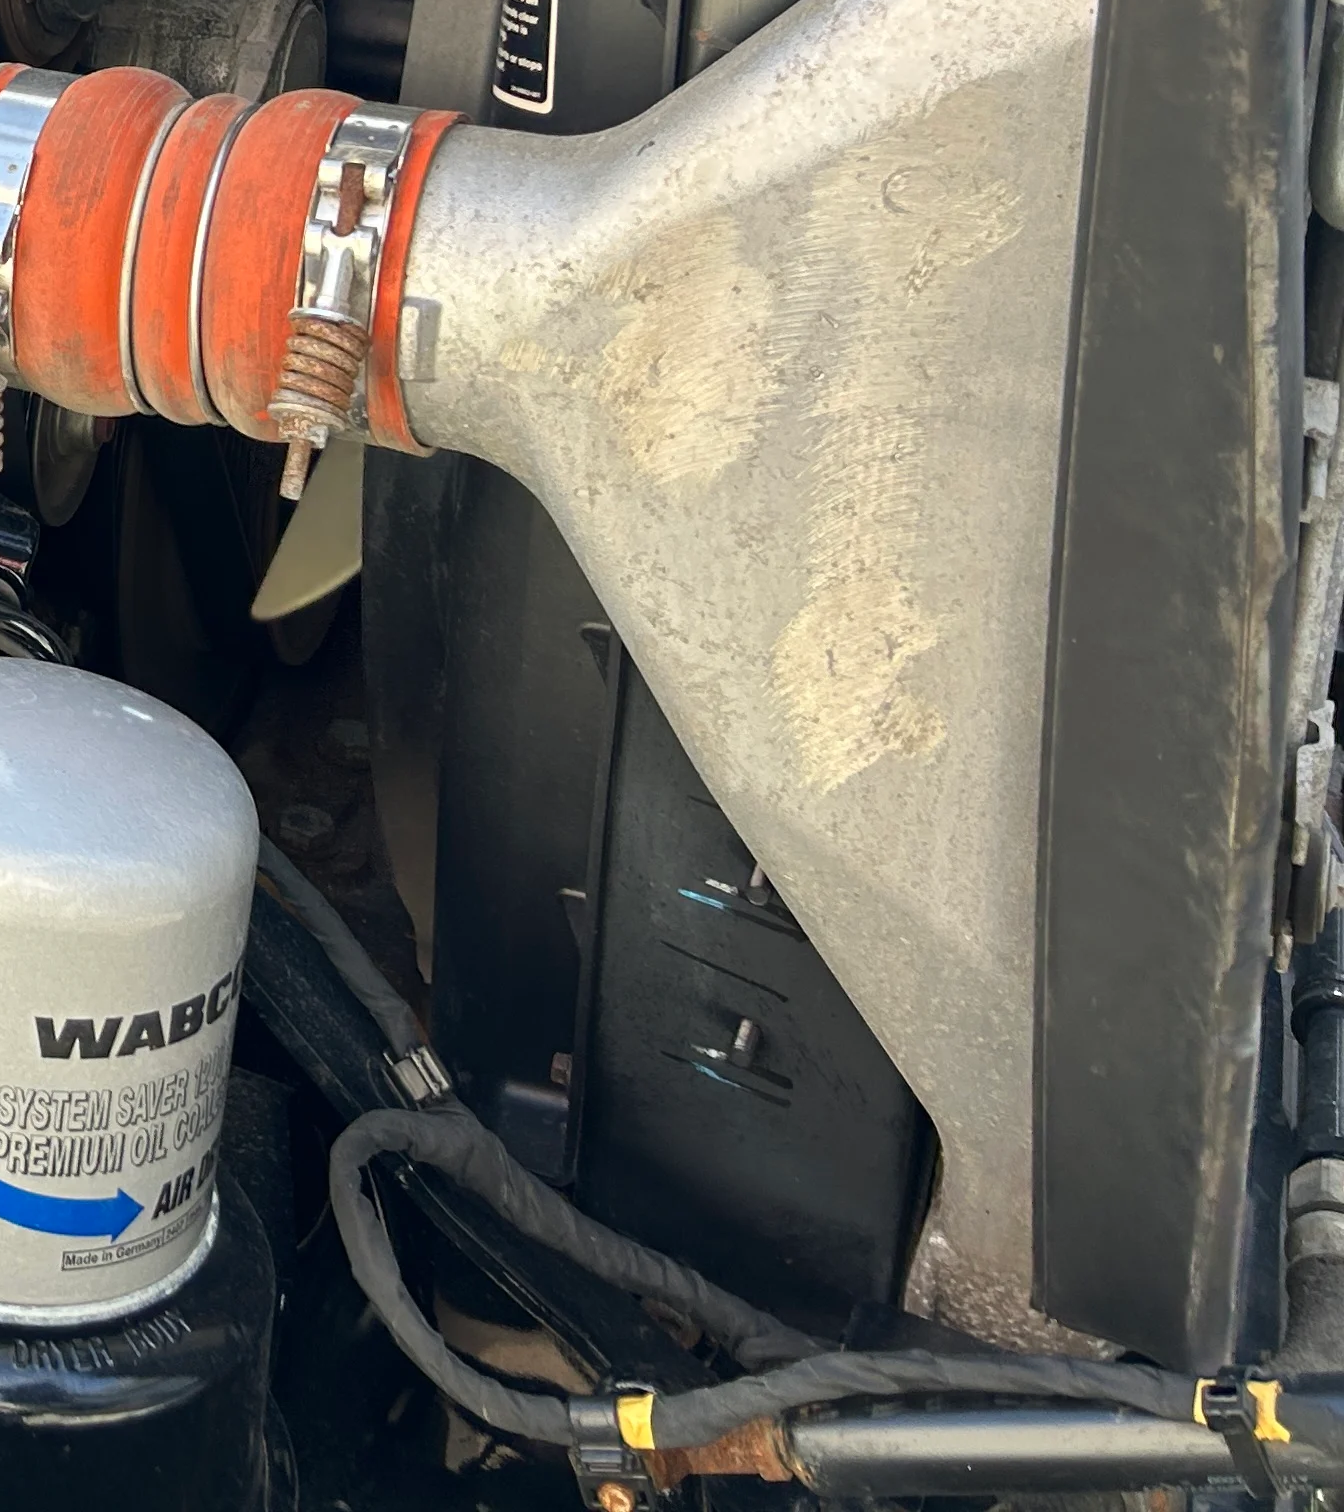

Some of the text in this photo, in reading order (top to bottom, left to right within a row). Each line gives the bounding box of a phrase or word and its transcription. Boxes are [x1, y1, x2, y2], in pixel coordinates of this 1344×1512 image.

[115, 1068, 190, 1128] SAVER
[129, 1122, 168, 1168] OIL
[151, 1165, 196, 1221] AIR
[64, 1252, 100, 1267] Made
[101, 1249, 113, 1262] in
[115, 1237, 162, 1260] Germany
